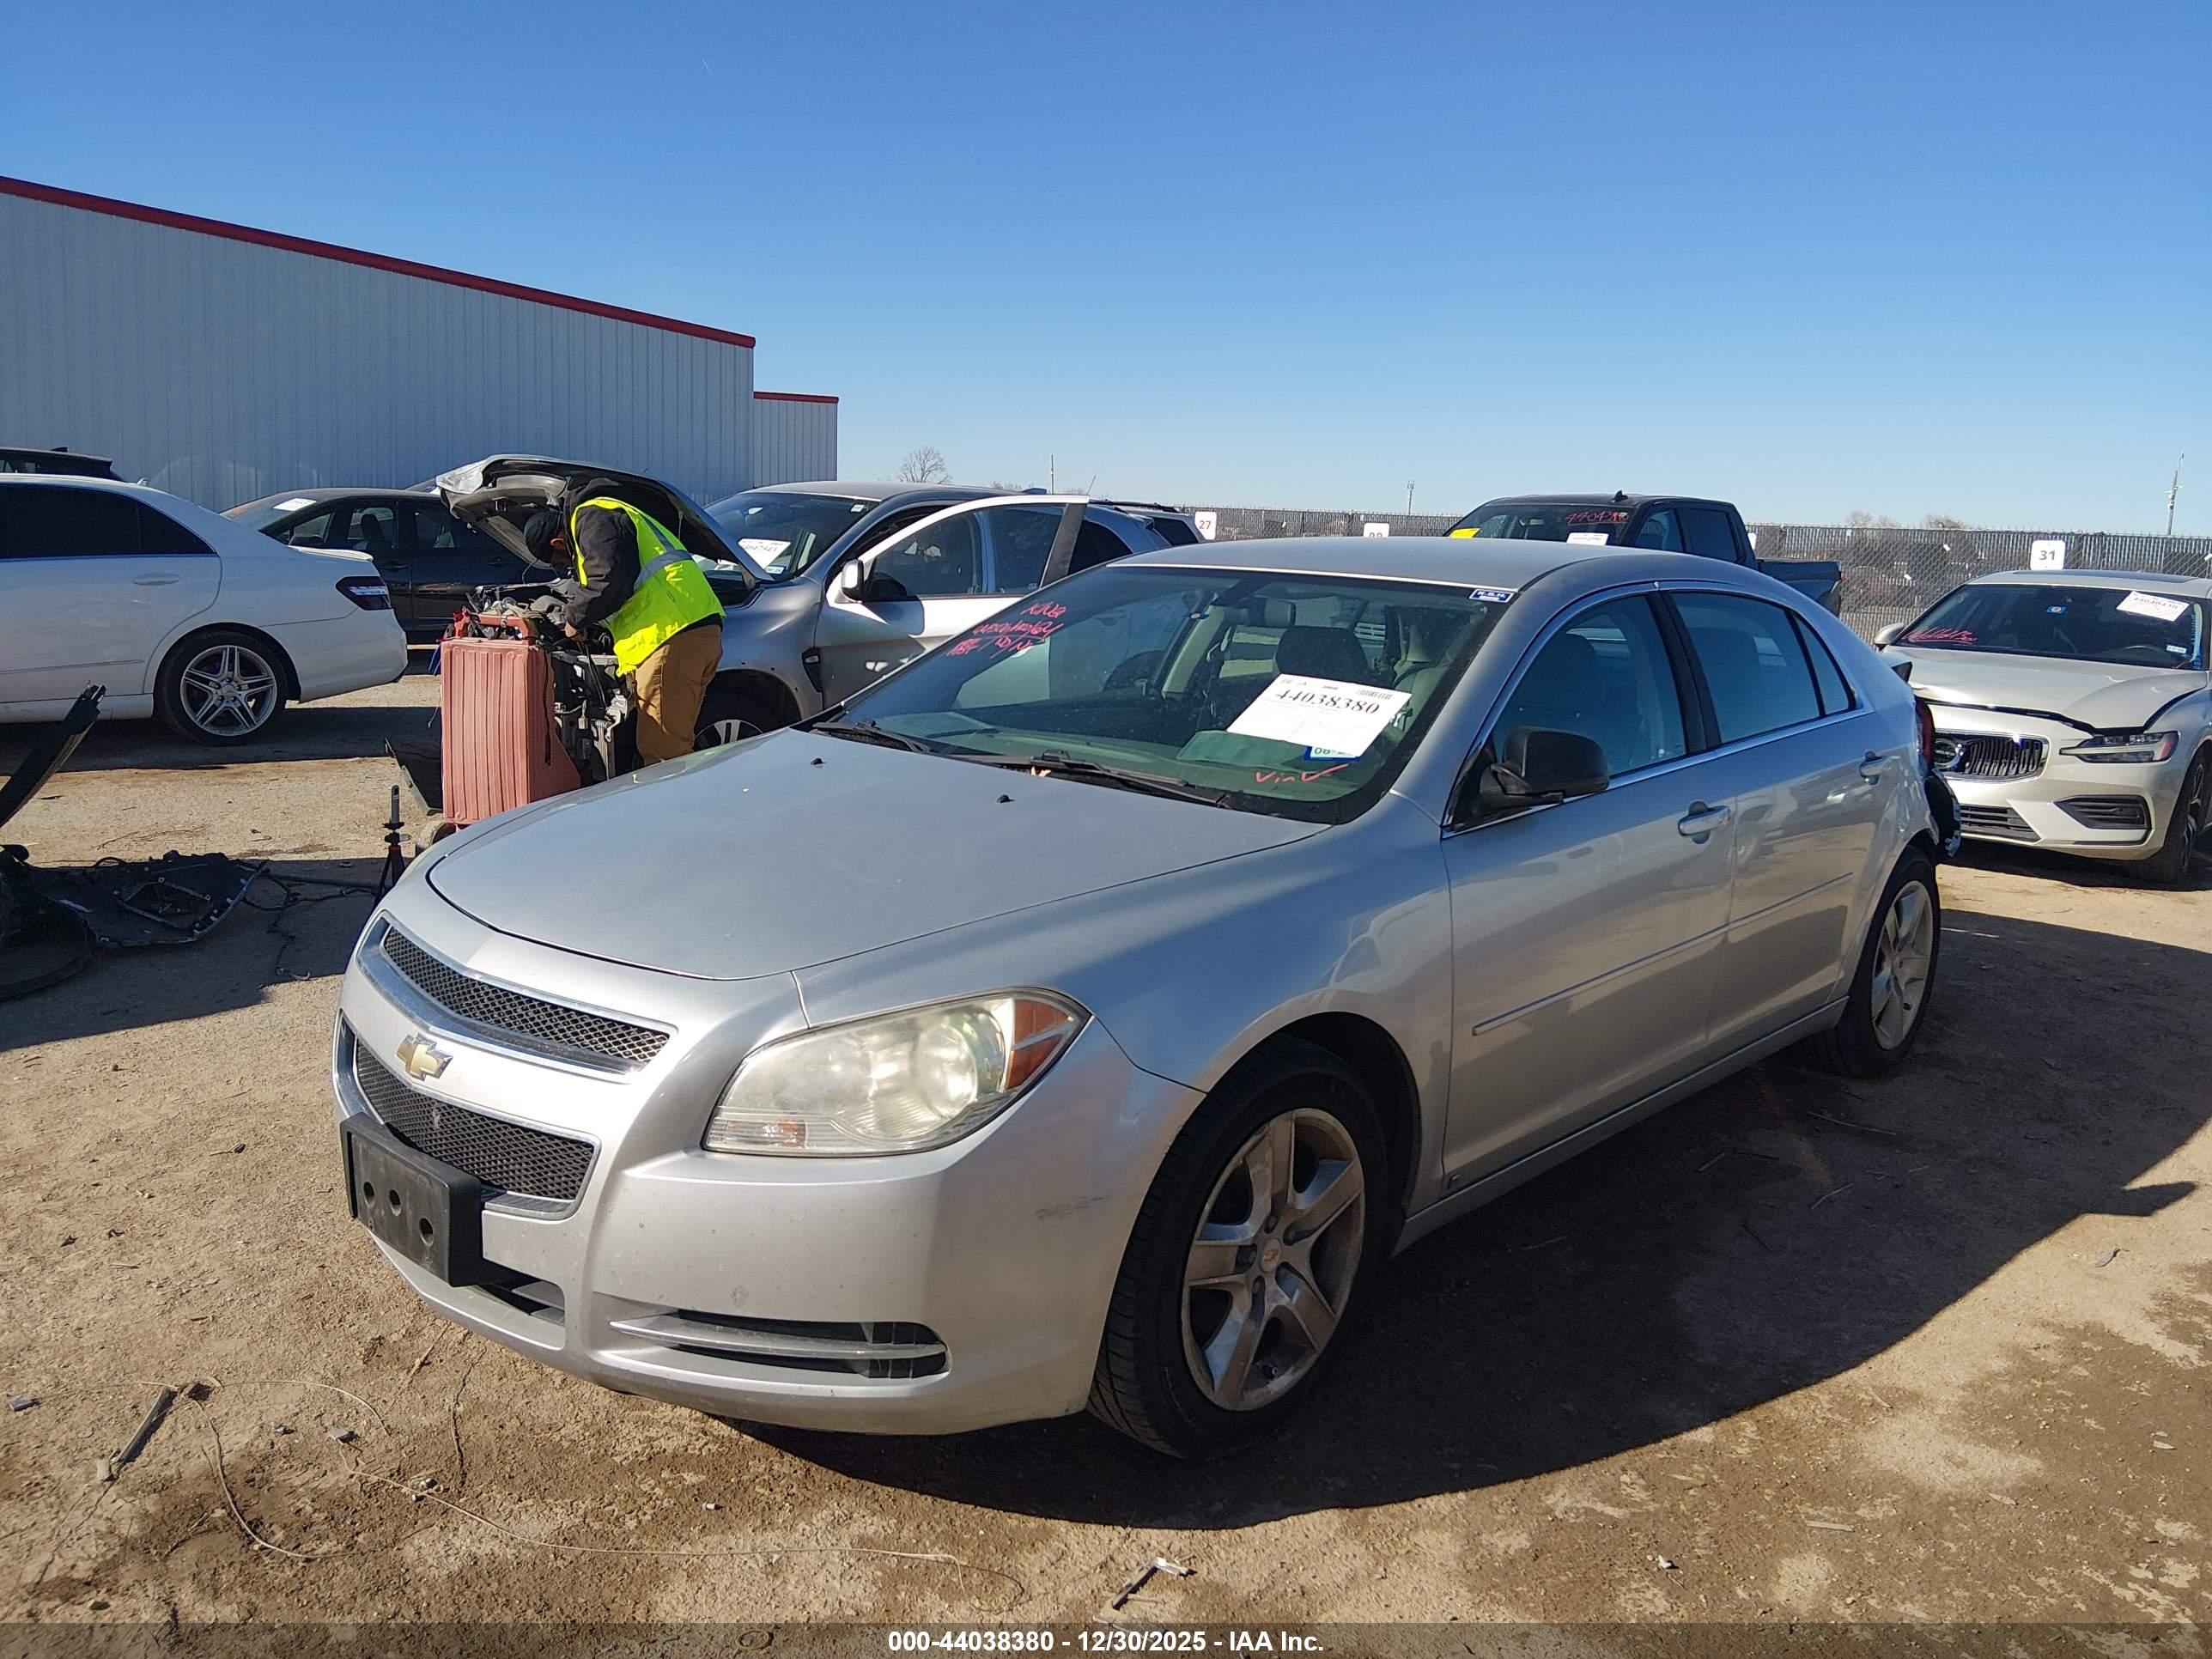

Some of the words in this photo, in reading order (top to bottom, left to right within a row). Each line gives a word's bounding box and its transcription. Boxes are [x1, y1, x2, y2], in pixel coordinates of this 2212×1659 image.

[1199, 520, 1212, 530] 27
[2039, 550, 2056, 561] 31
[1276, 689, 1381, 714] 44038380
